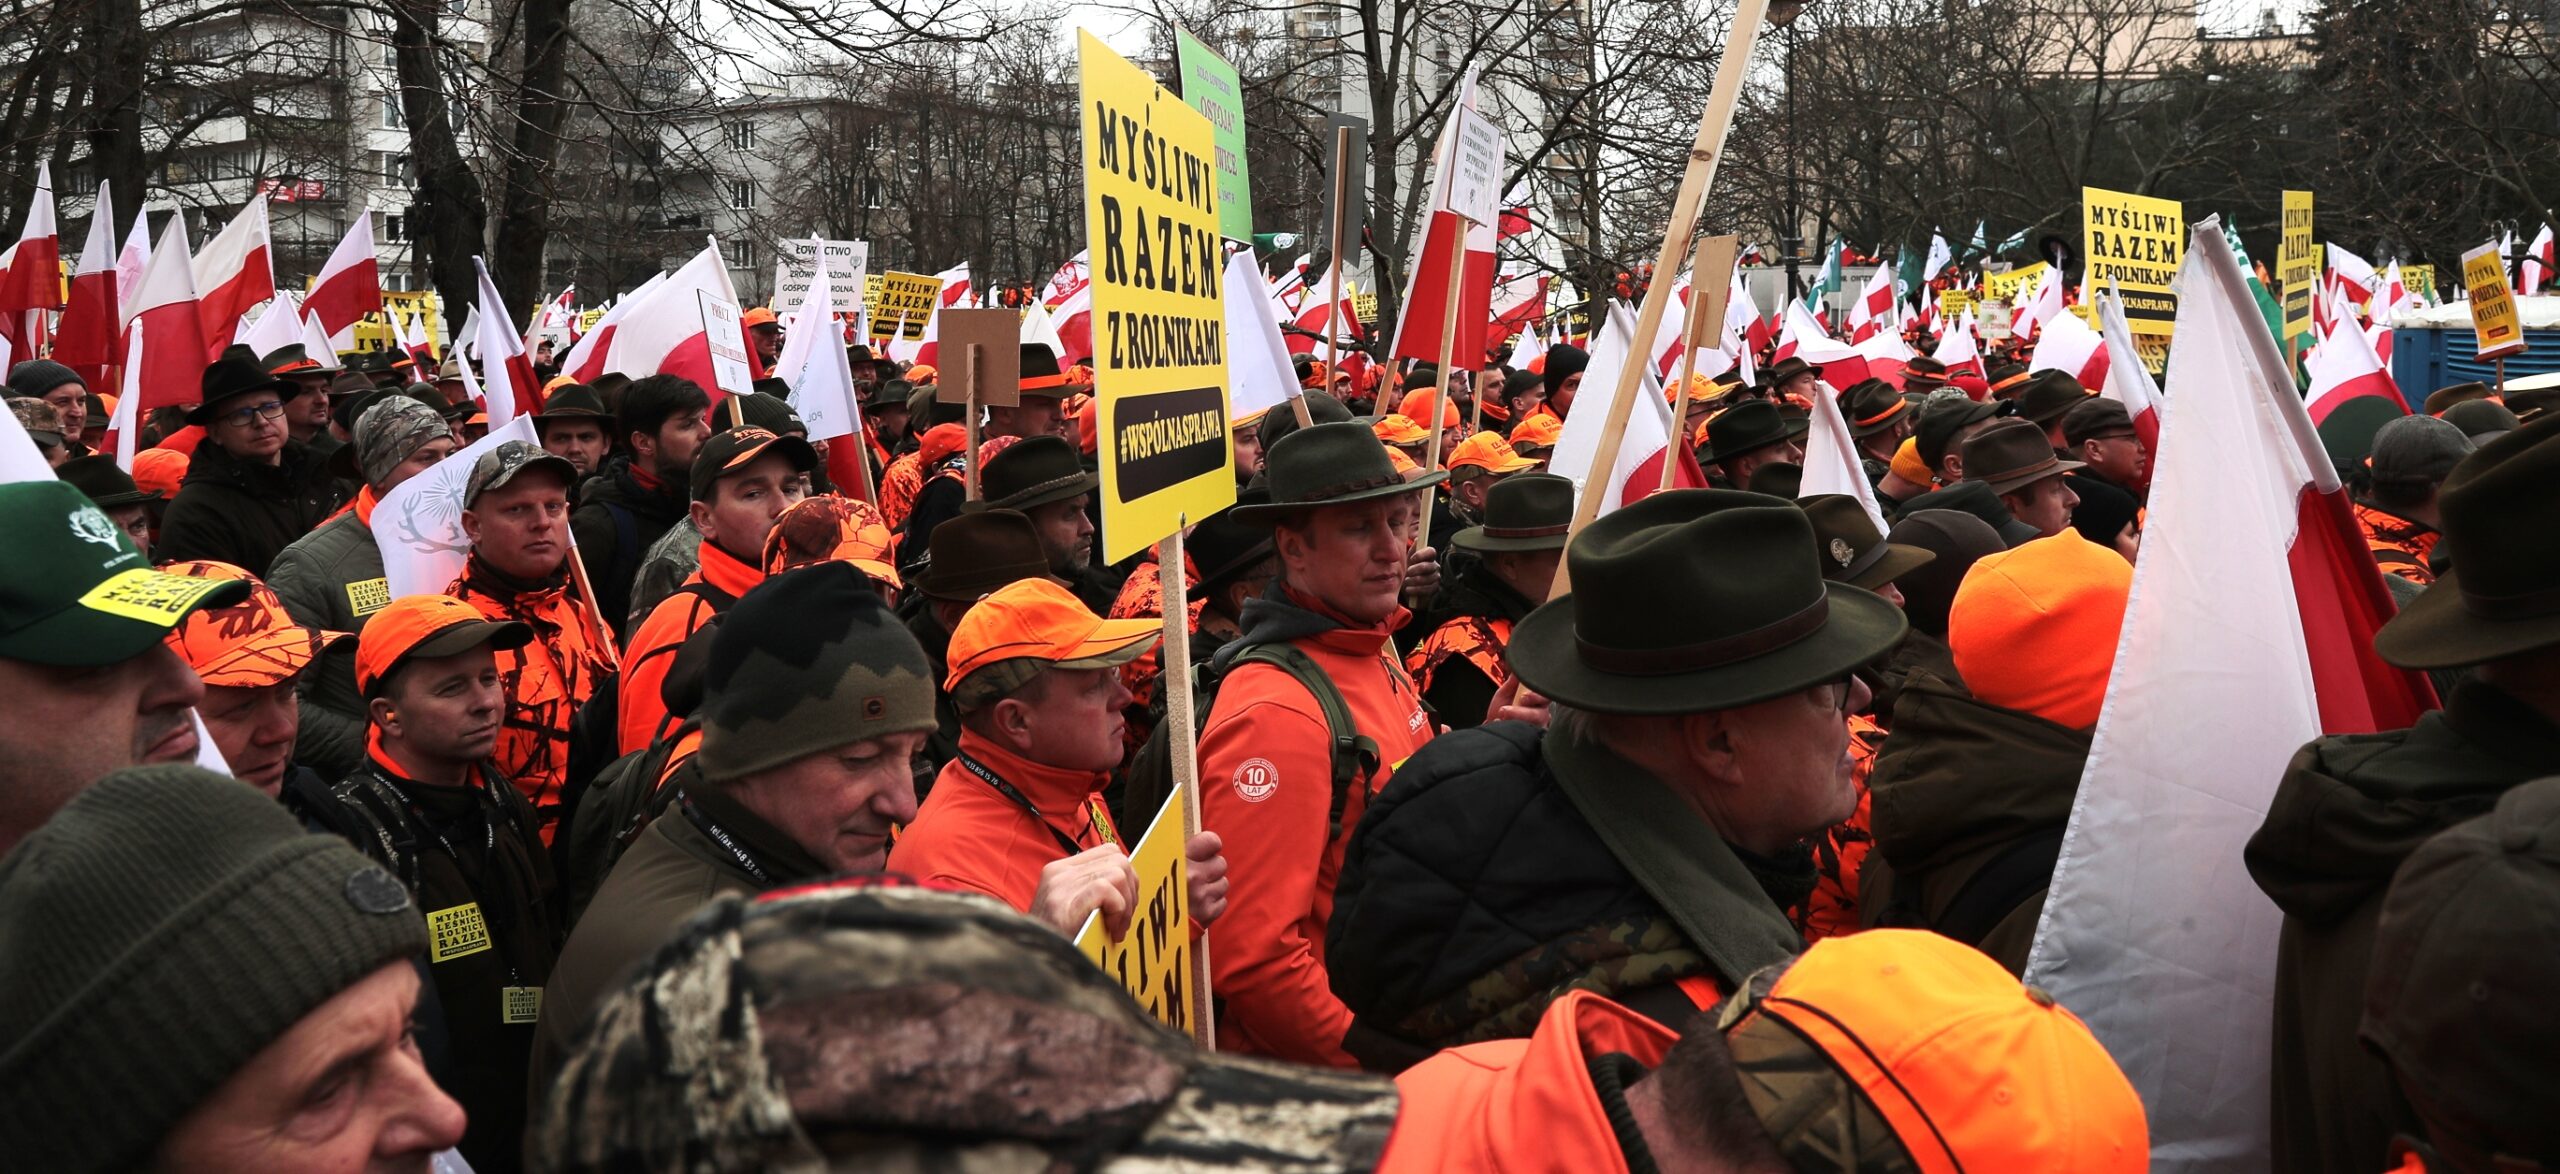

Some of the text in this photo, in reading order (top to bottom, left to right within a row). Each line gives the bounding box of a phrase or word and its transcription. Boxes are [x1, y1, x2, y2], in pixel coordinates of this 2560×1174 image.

[1096, 100, 1213, 214] MYŚLIWI
[2091, 202, 2176, 235] MYŚLIWI
[796, 244, 851, 256] ŁOWCTWO
[1101, 193, 1218, 300] RAZEM
[2092, 231, 2177, 265] RAZEM
[790, 270, 852, 279] ZRÓWNAŻONA
[2094, 263, 2103, 280] Z
[886, 279, 938, 296] MYŚLIWI
[881, 292, 933, 310] RAZEM
[2120, 294, 2175, 312] ÓLNASPRAWA
[1108, 310, 1222, 370] Z ROLNIKAMI
[1120, 409, 1222, 465] #WSPÓLNASPRAWA
[1246, 767, 1266, 785] 10
[1246, 786, 1263, 794] LAT
[435, 906, 481, 924] MYŚLIWI
[436, 914, 482, 932] LEŚNICY
[438, 921, 484, 939] ROLNICY
[439, 929, 486, 950] RAZEM
